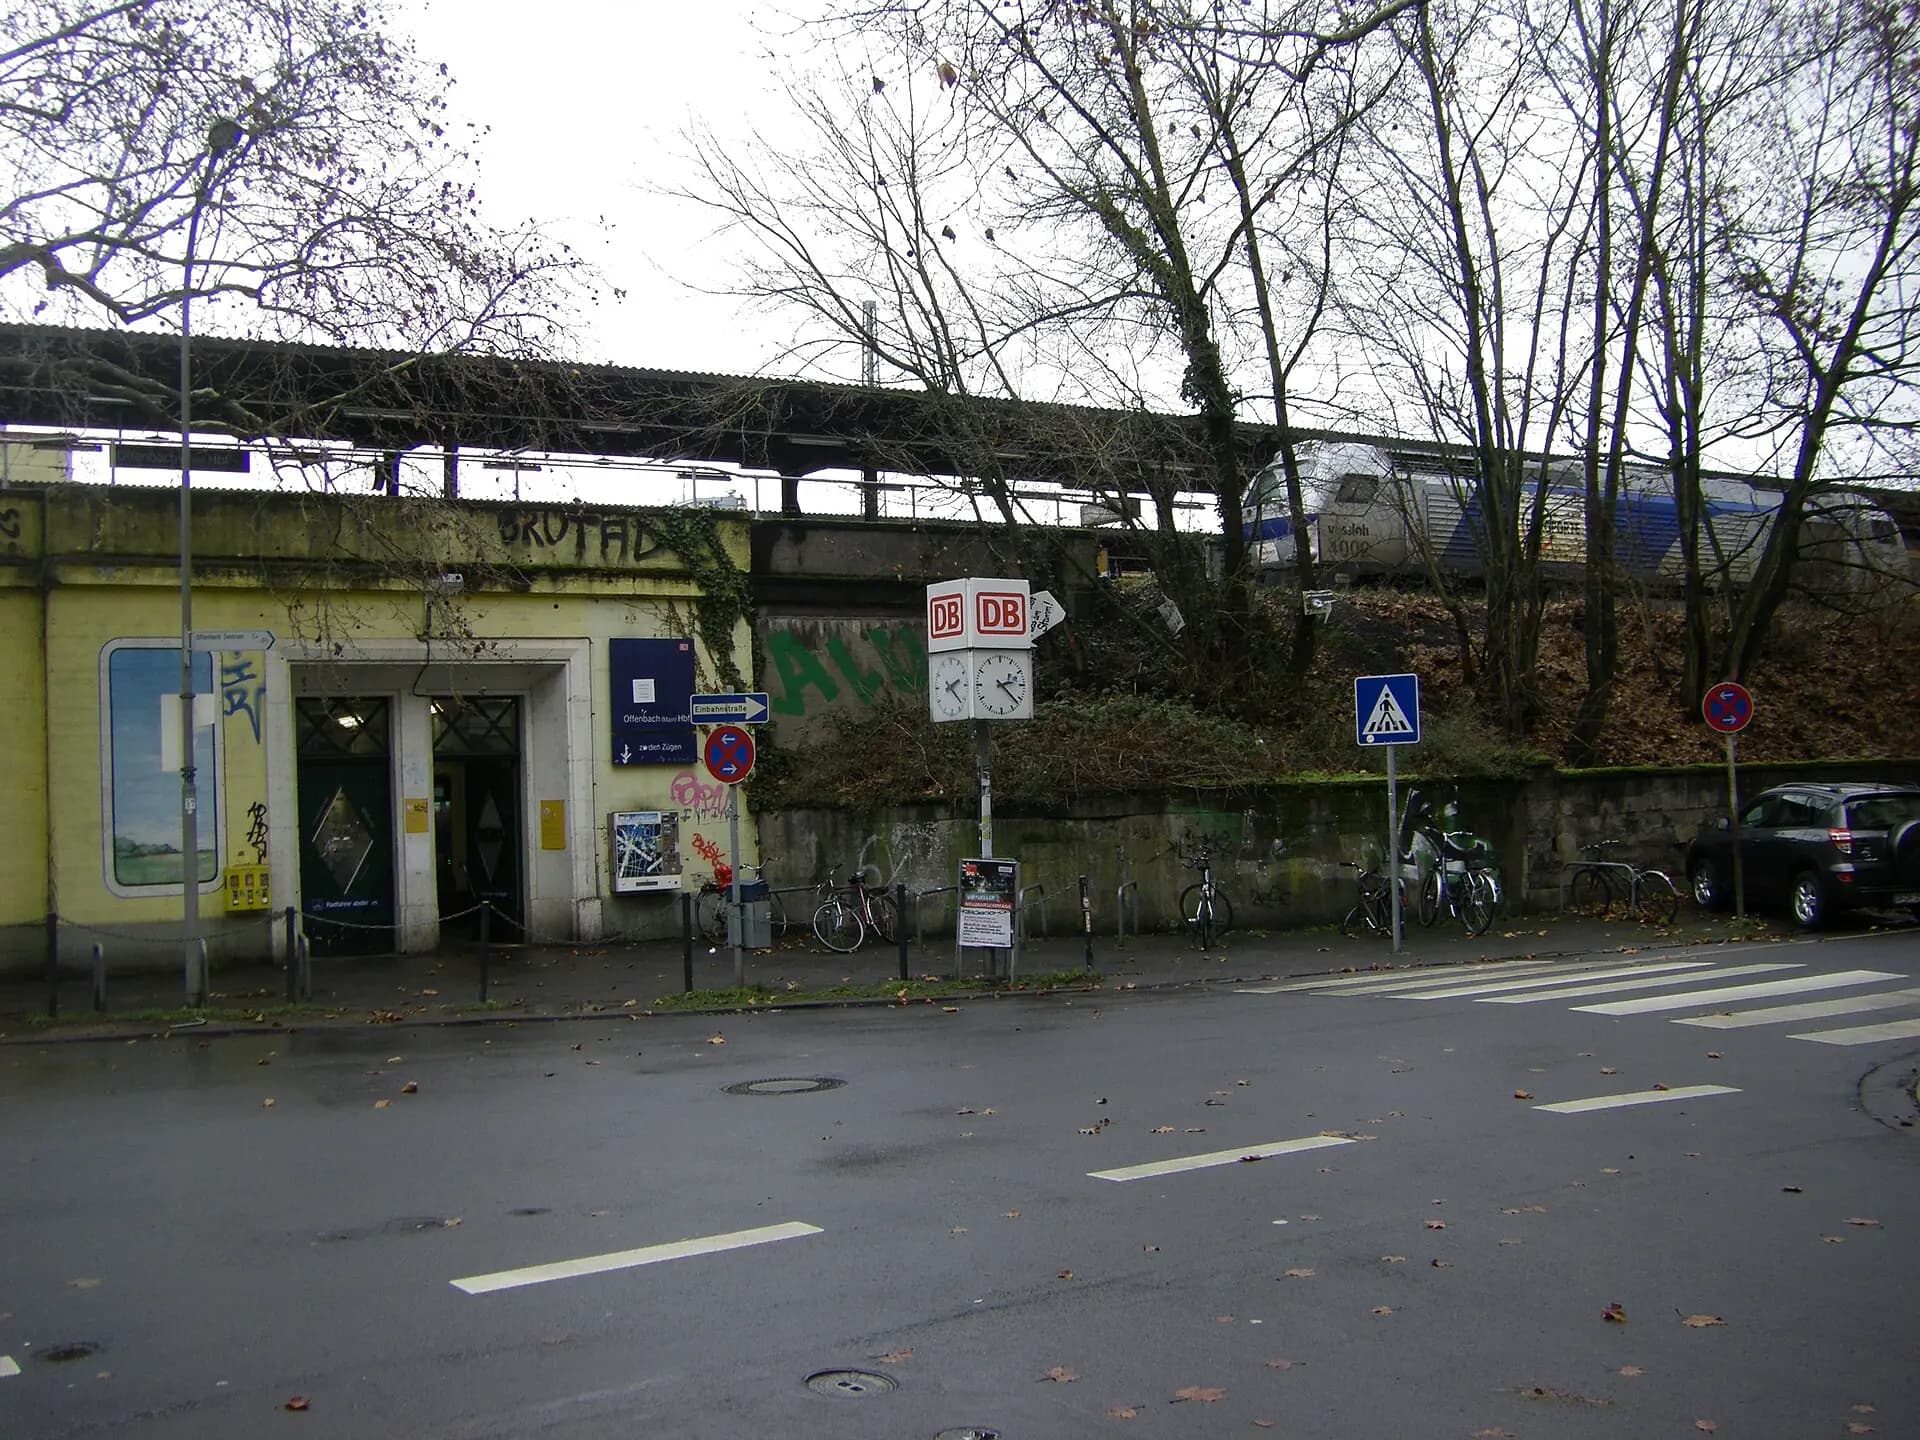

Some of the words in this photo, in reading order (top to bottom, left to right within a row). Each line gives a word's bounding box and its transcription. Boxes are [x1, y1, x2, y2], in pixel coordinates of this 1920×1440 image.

[934, 601, 960, 632] DB
[982, 599, 1020, 628] DB
[694, 705, 747, 713] Einbahnstraße
[623, 714, 661, 723] Offenbach
[661, 743, 682, 752] Zügen
